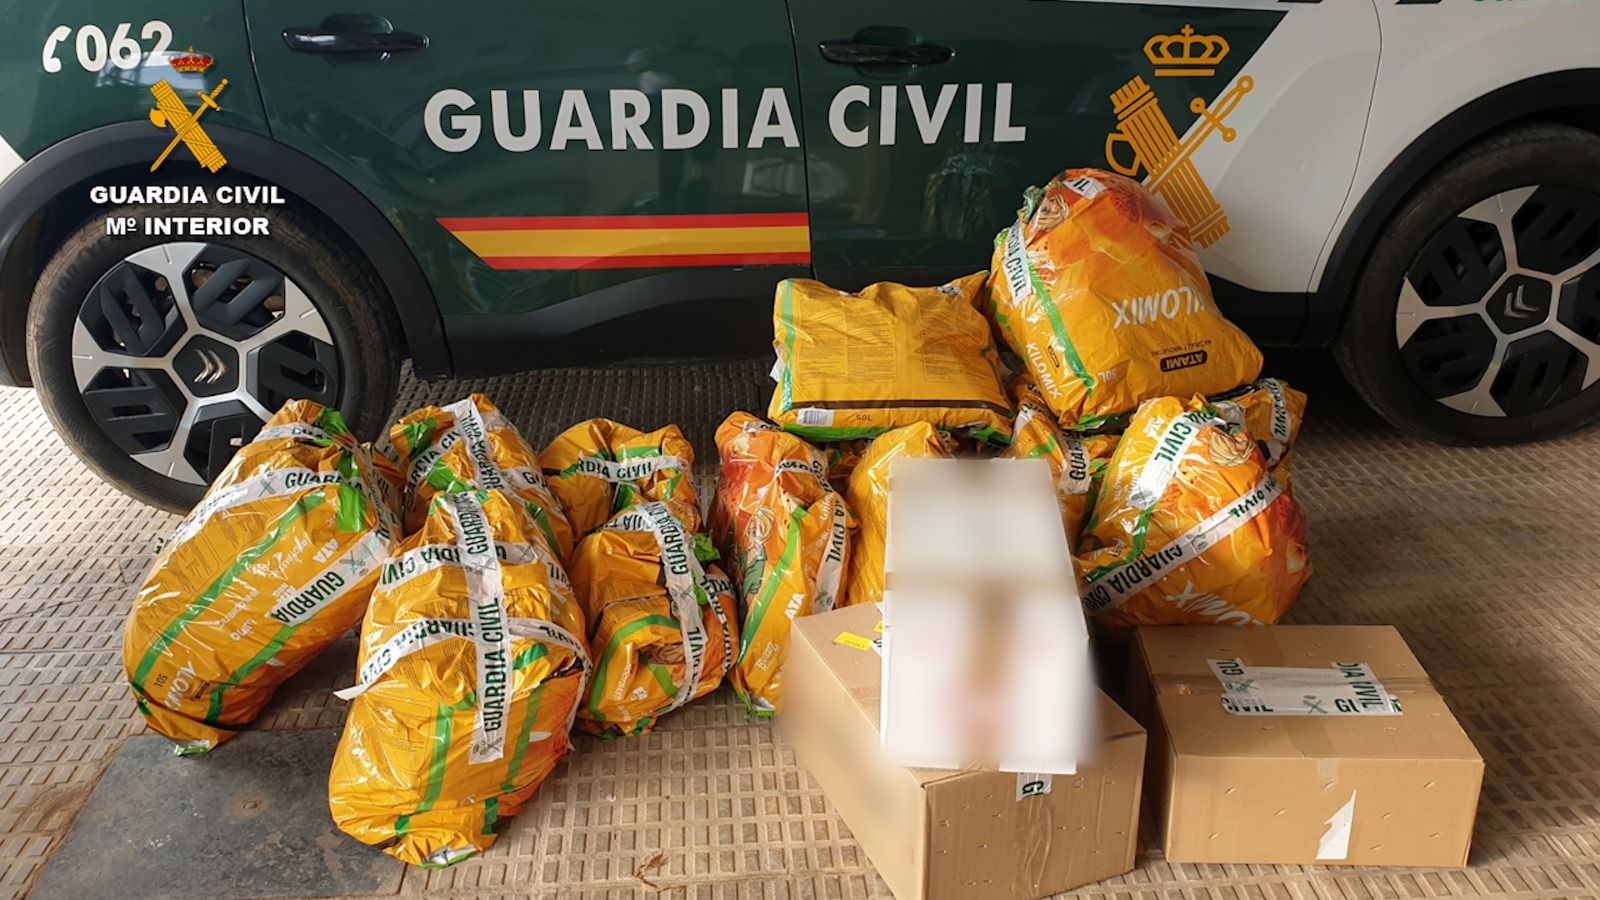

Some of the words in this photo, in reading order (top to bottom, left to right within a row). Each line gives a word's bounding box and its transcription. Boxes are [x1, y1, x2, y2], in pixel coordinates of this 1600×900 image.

[76, 20, 173, 71] 062
[424, 88, 801, 153] GUARDIA
[828, 82, 1027, 148] CIVIL
[1112, 286, 1205, 330] ILOMIX
[1025, 342, 1064, 400] KILOMIX
[1165, 352, 1205, 371] ATAMI
[1155, 422, 1193, 461] CIVIL
[576, 459, 610, 478] RDIA
[1107, 544, 1184, 596] GUARDIA
[271, 571, 345, 625] GUARDIA
[478, 597, 503, 643] CIVIL
[784, 592, 806, 620] ATA
[483, 649, 507, 732] GUARDIA
